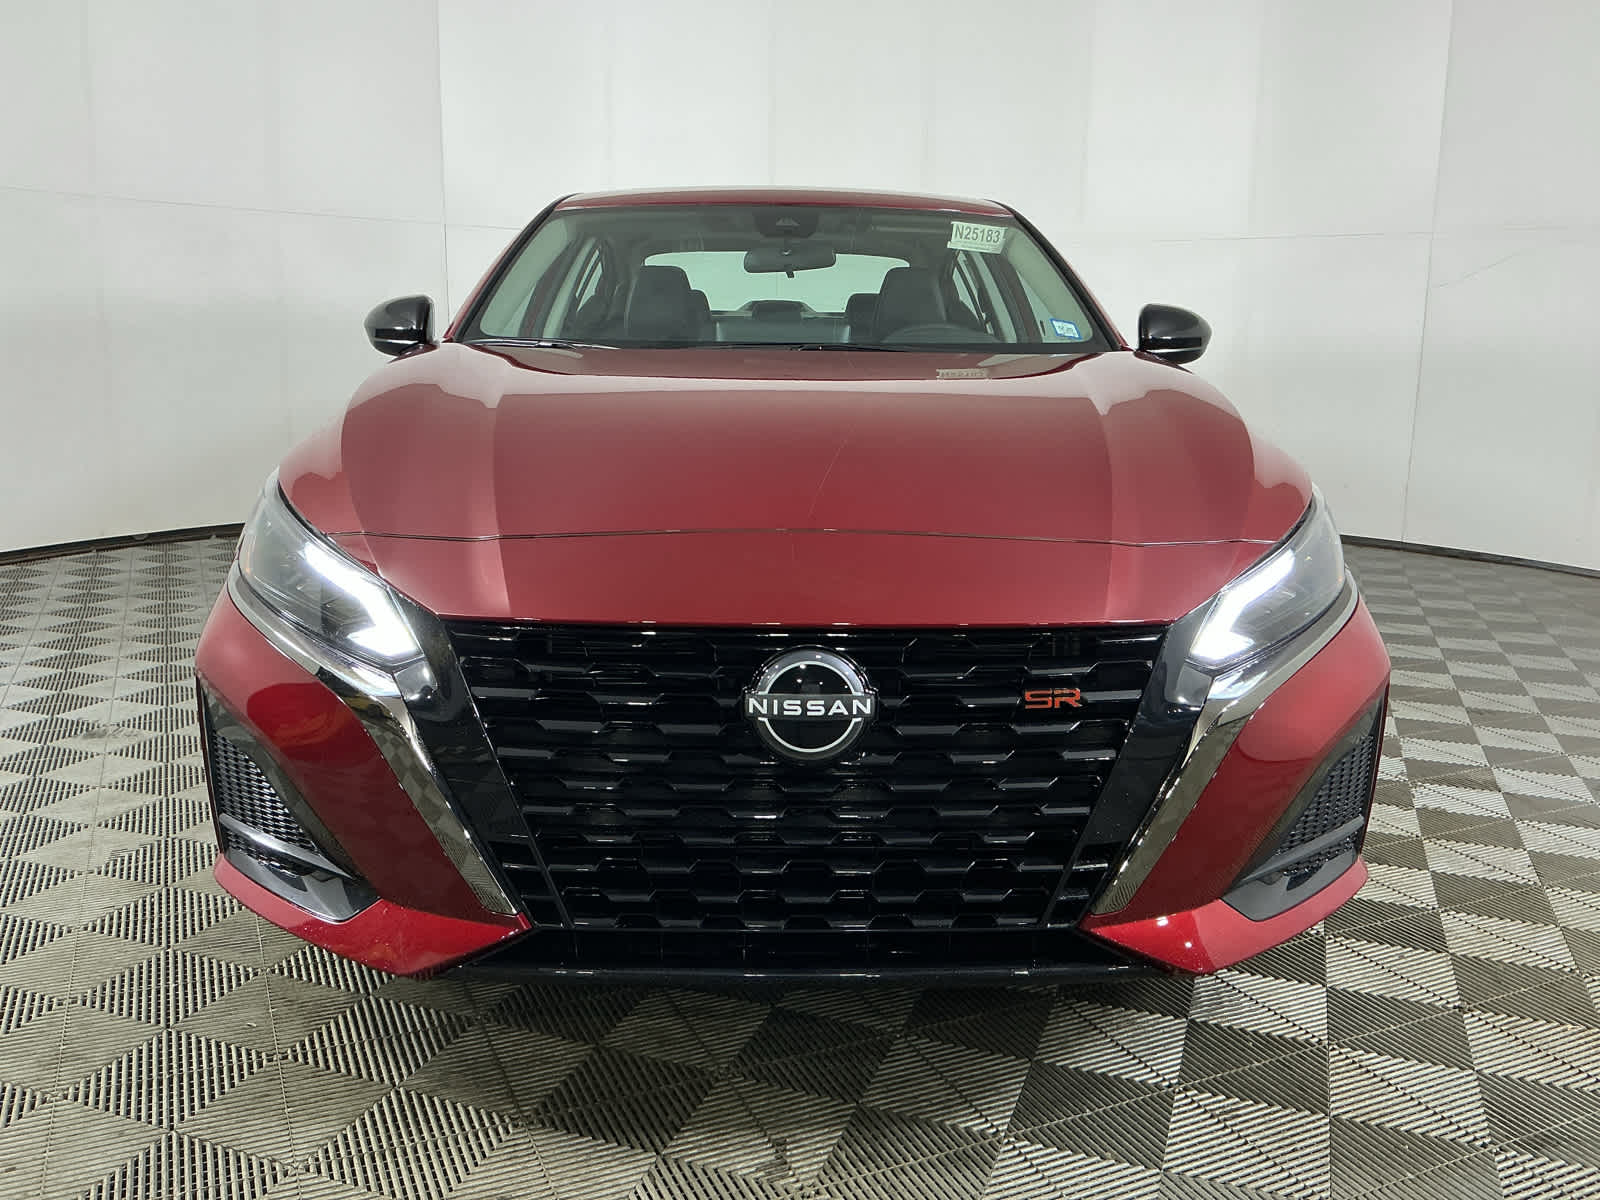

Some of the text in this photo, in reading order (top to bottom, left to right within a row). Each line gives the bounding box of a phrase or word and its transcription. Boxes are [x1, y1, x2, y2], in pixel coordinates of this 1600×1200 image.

[954, 224, 1001, 243] N25183
[748, 697, 871, 716] NISSAN
[1024, 688, 1081, 709] SR
